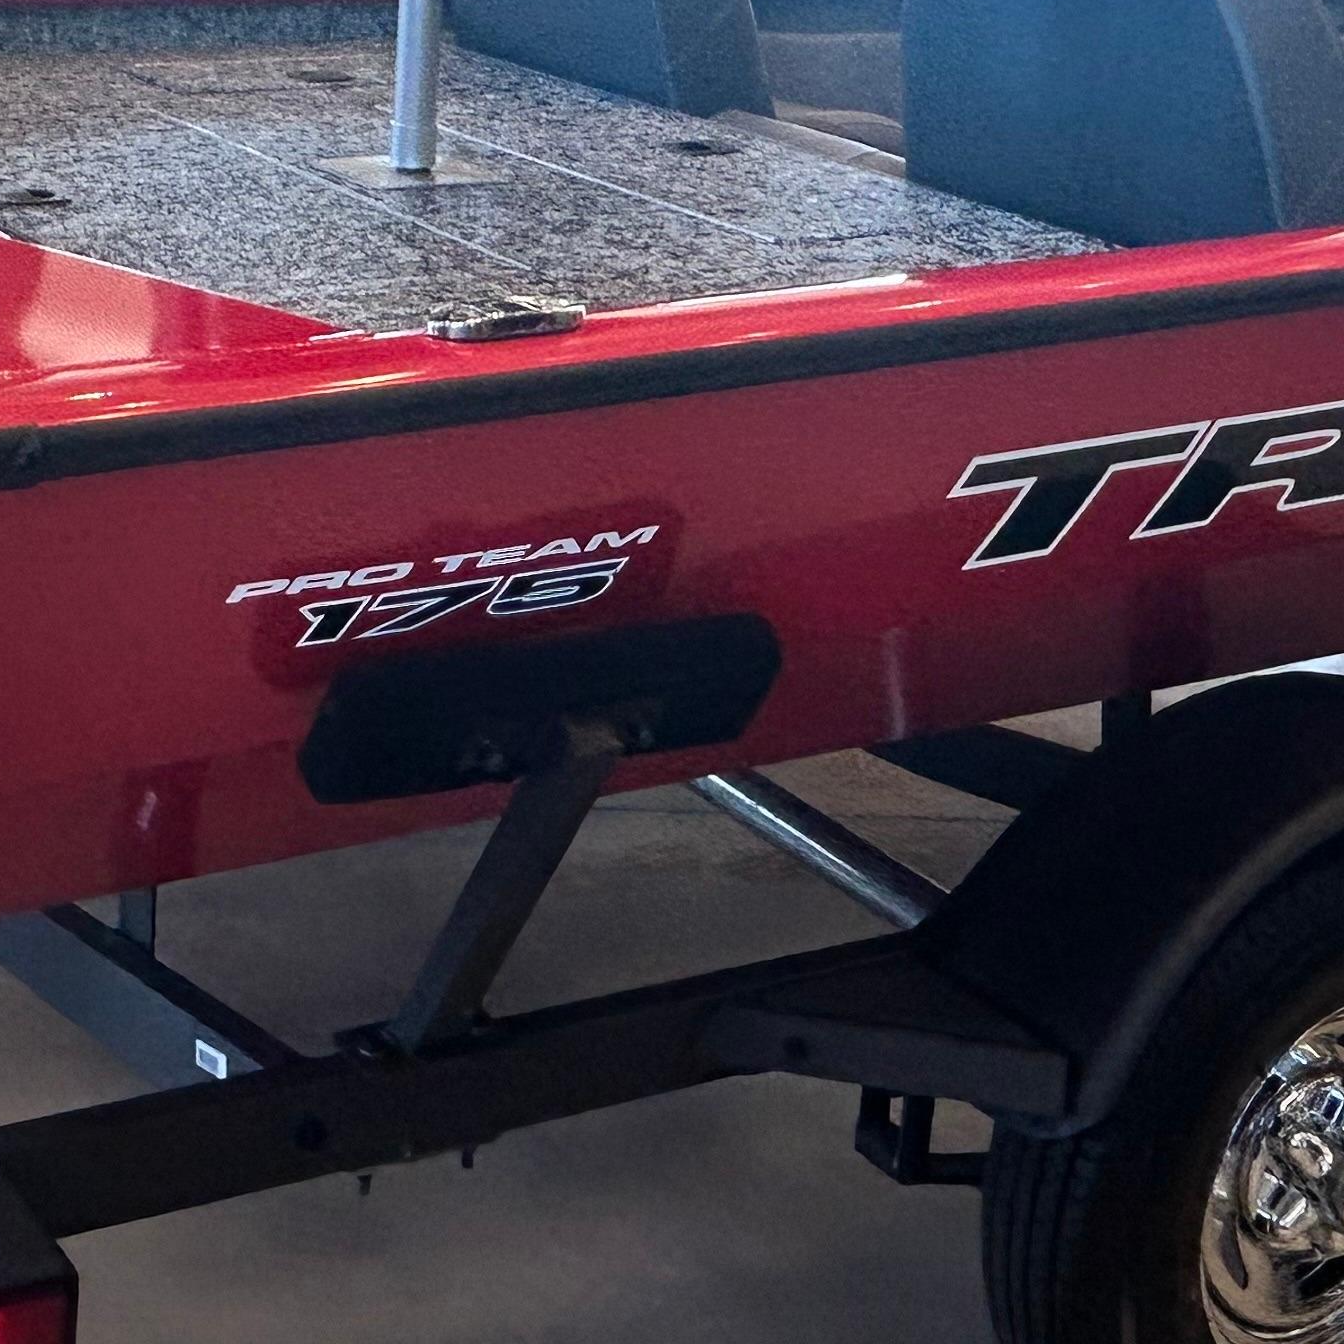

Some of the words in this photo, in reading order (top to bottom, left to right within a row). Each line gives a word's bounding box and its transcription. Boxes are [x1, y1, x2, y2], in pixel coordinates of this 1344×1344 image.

[225, 562, 414, 604] PRO
[433, 525, 660, 568] TEAM
[295, 556, 630, 648] 175
